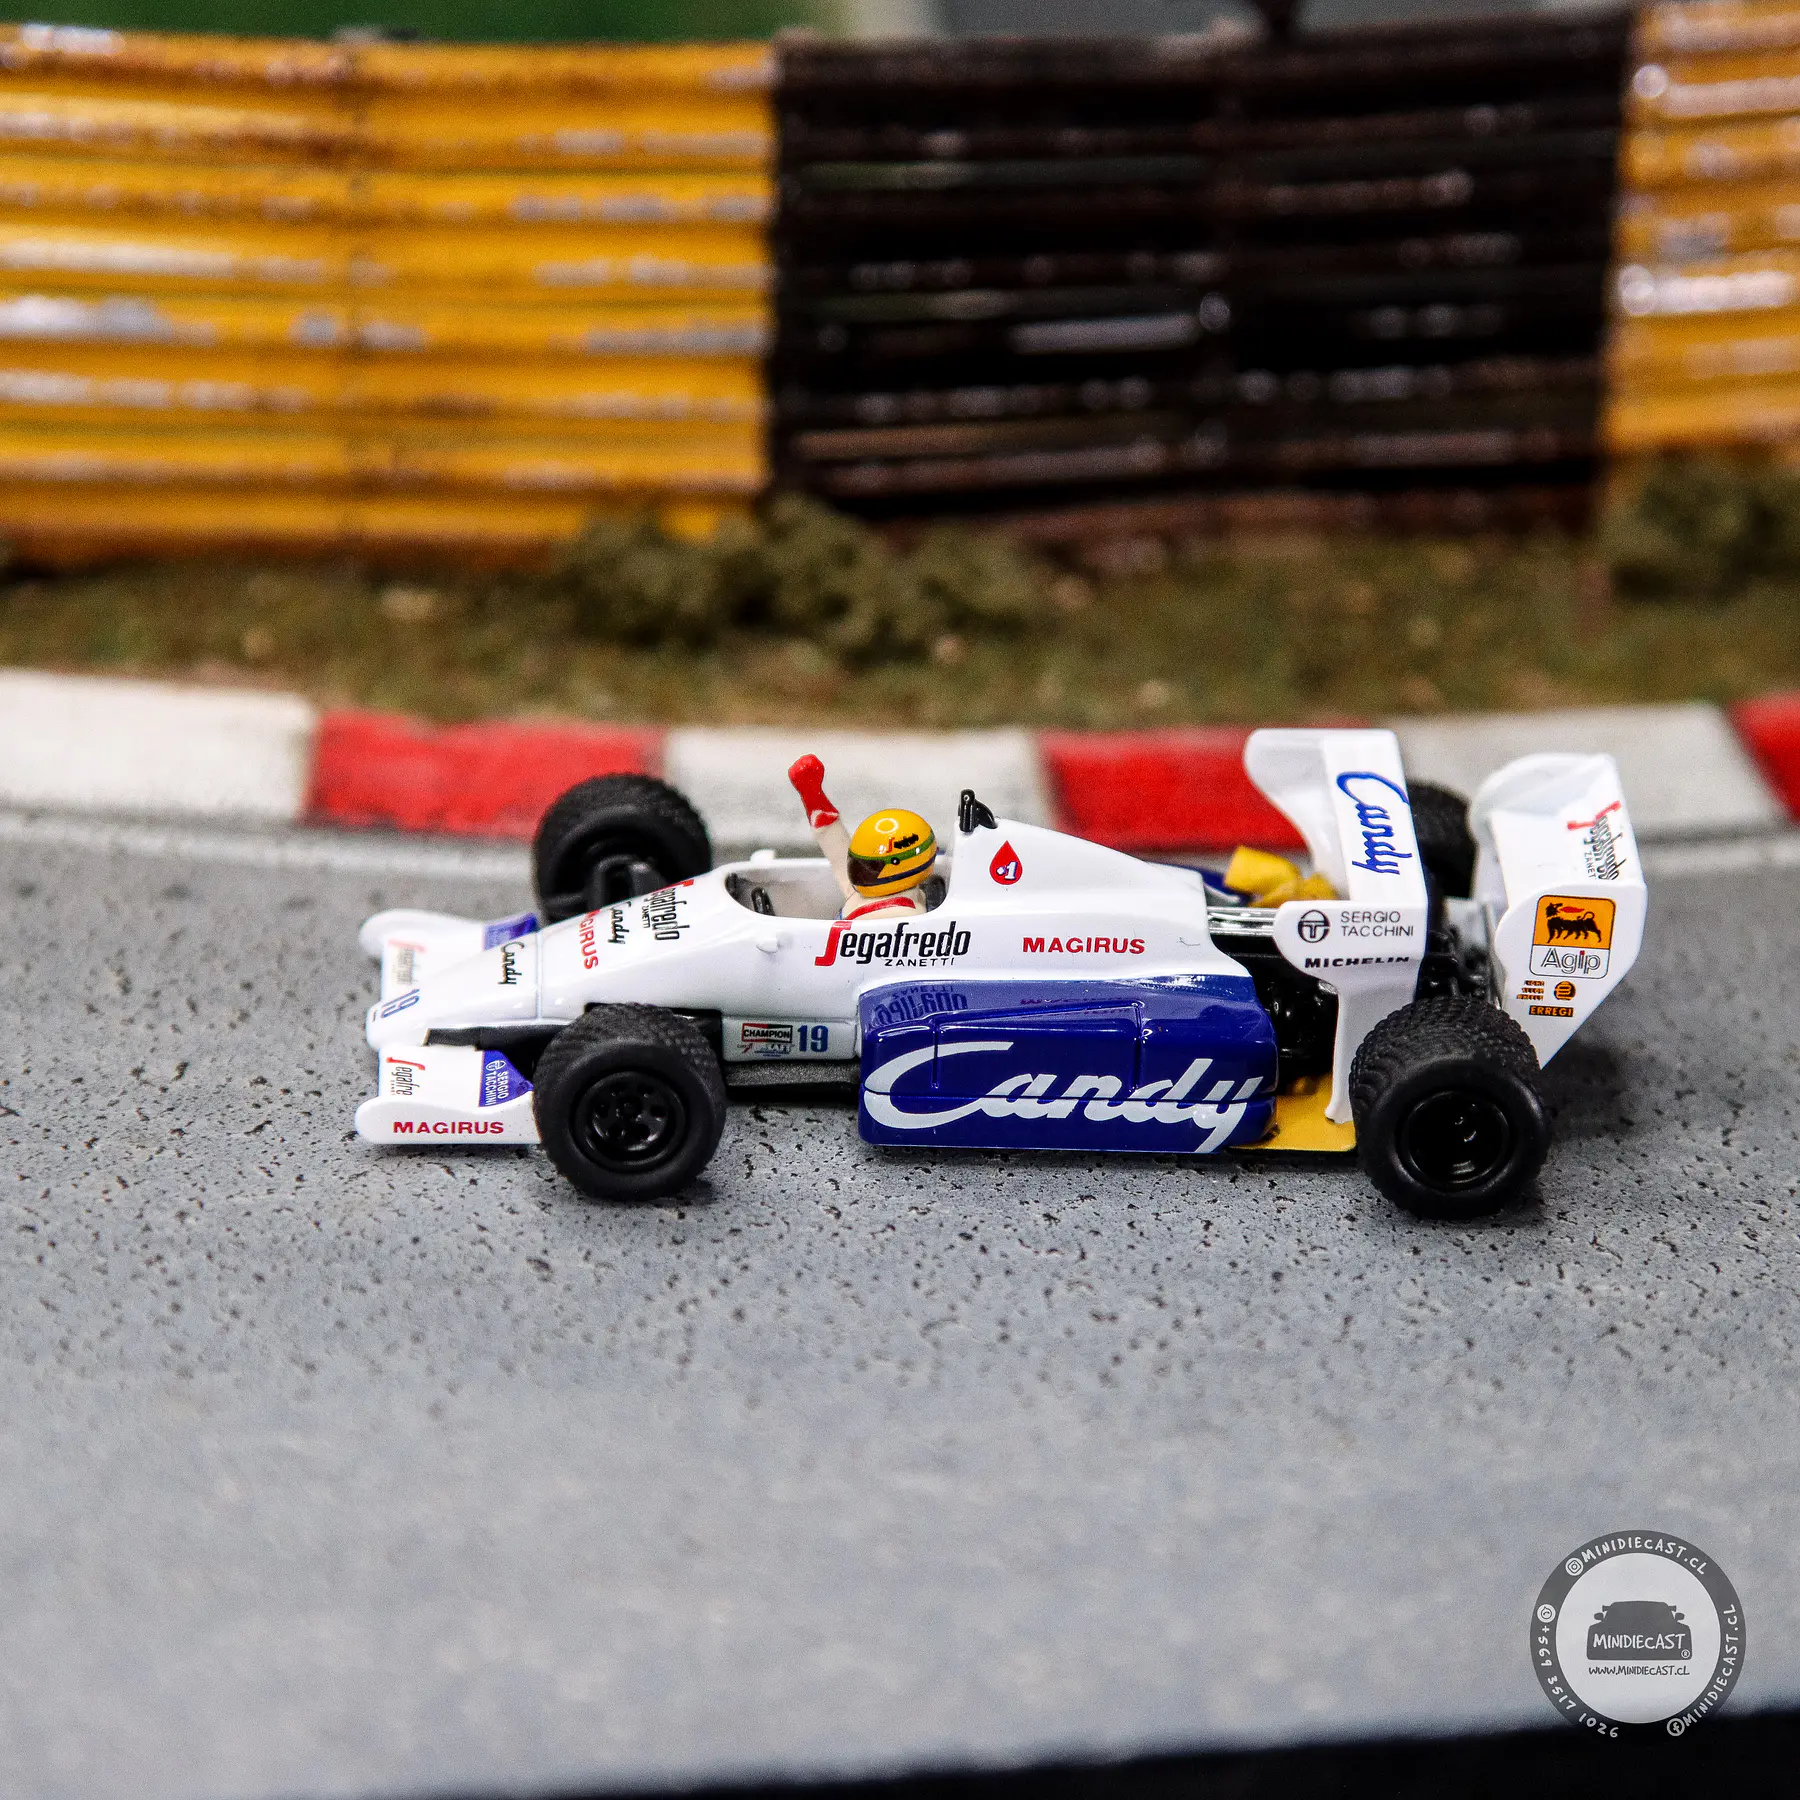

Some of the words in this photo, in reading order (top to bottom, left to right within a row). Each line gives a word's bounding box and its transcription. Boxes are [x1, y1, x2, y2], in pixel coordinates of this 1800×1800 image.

[1336, 771, 1412, 875] Candy
[1341, 911, 1401, 923] SERGIO
[1341, 925, 1414, 937] TACCHINI
[814, 921, 971, 967] Segafredo
[1023, 937, 1146, 954] MAGIRUS
[498, 942, 524, 985] Candy
[884, 958, 955, 967] ZANETTI
[1305, 957, 1409, 968] MICHELIN
[1541, 948, 1601, 974] Agip
[380, 988, 419, 1018] 19
[1529, 1006, 1573, 1016] ERREGI
[743, 1029, 790, 1039] CHAMPION
[797, 1025, 829, 1053] 19
[498, 1071, 509, 1099] SERGIO
[864, 1041, 1263, 1153] Candy
[393, 1122, 504, 1134] MAGIRUS
